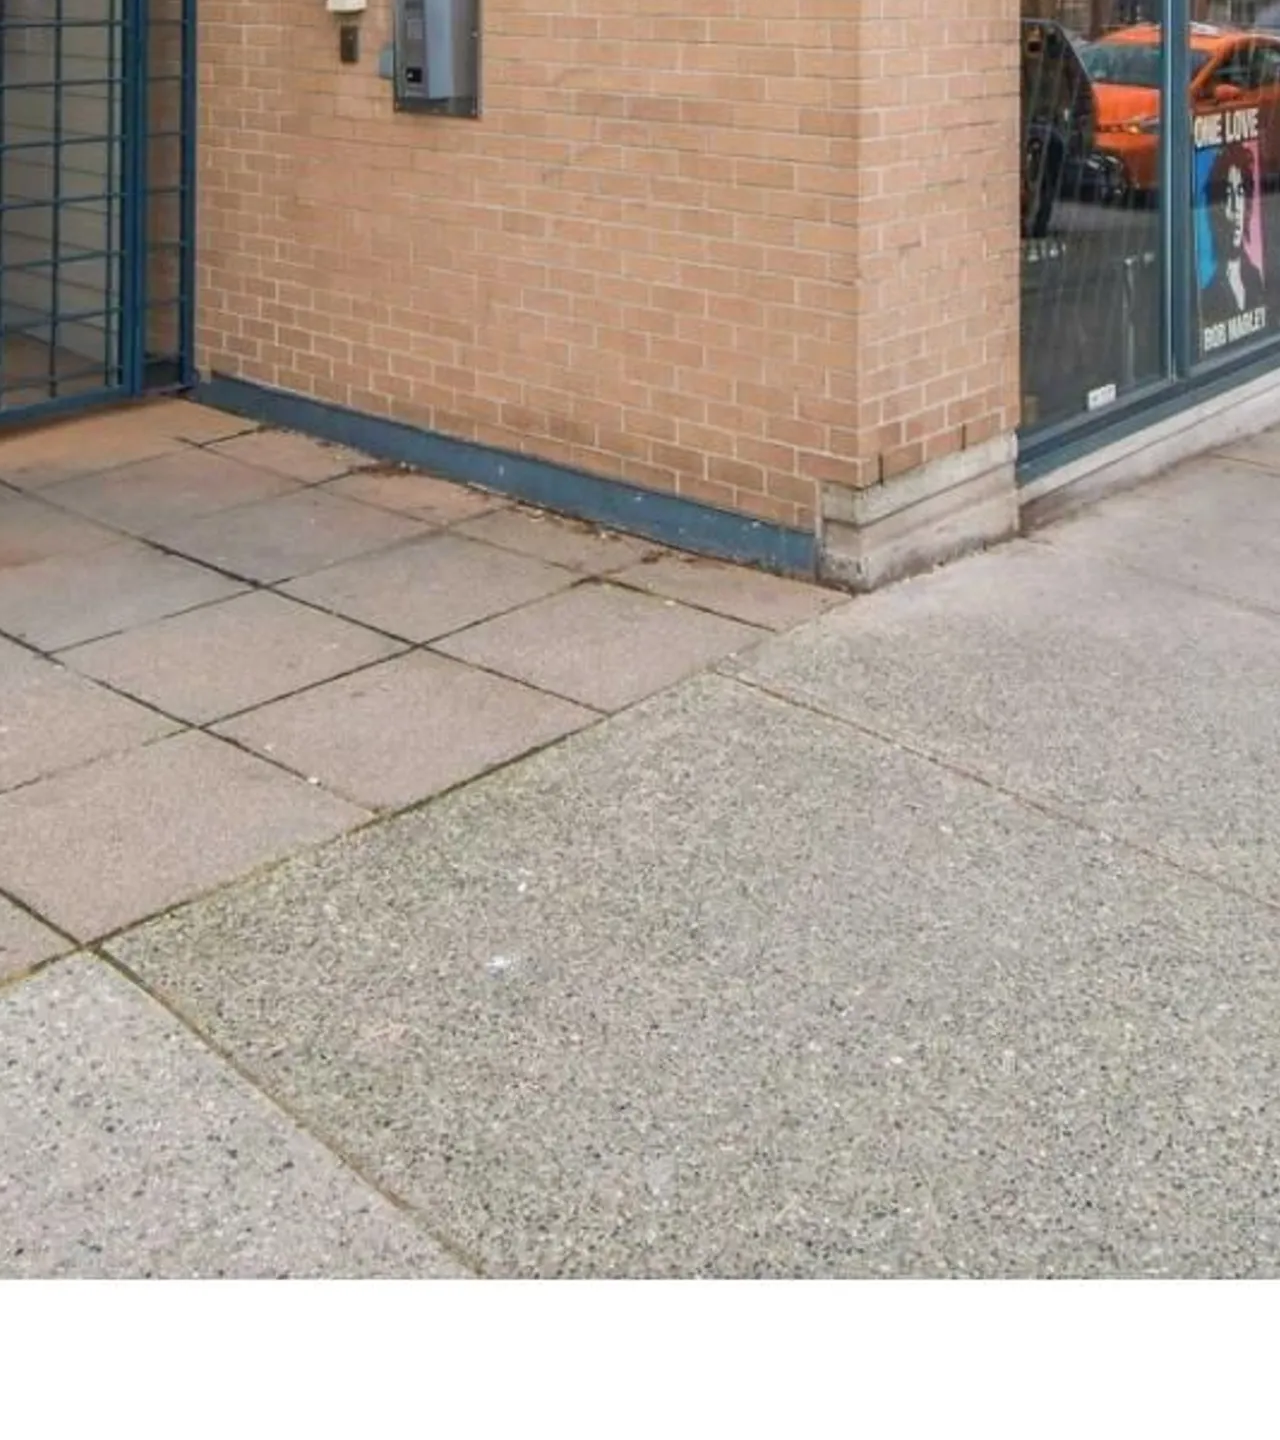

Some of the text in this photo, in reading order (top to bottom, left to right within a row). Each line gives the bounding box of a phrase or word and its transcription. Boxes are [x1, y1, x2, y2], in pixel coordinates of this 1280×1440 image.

[1194, 107, 1259, 148] ONE LOVE
[1204, 322, 1227, 352] BOB
